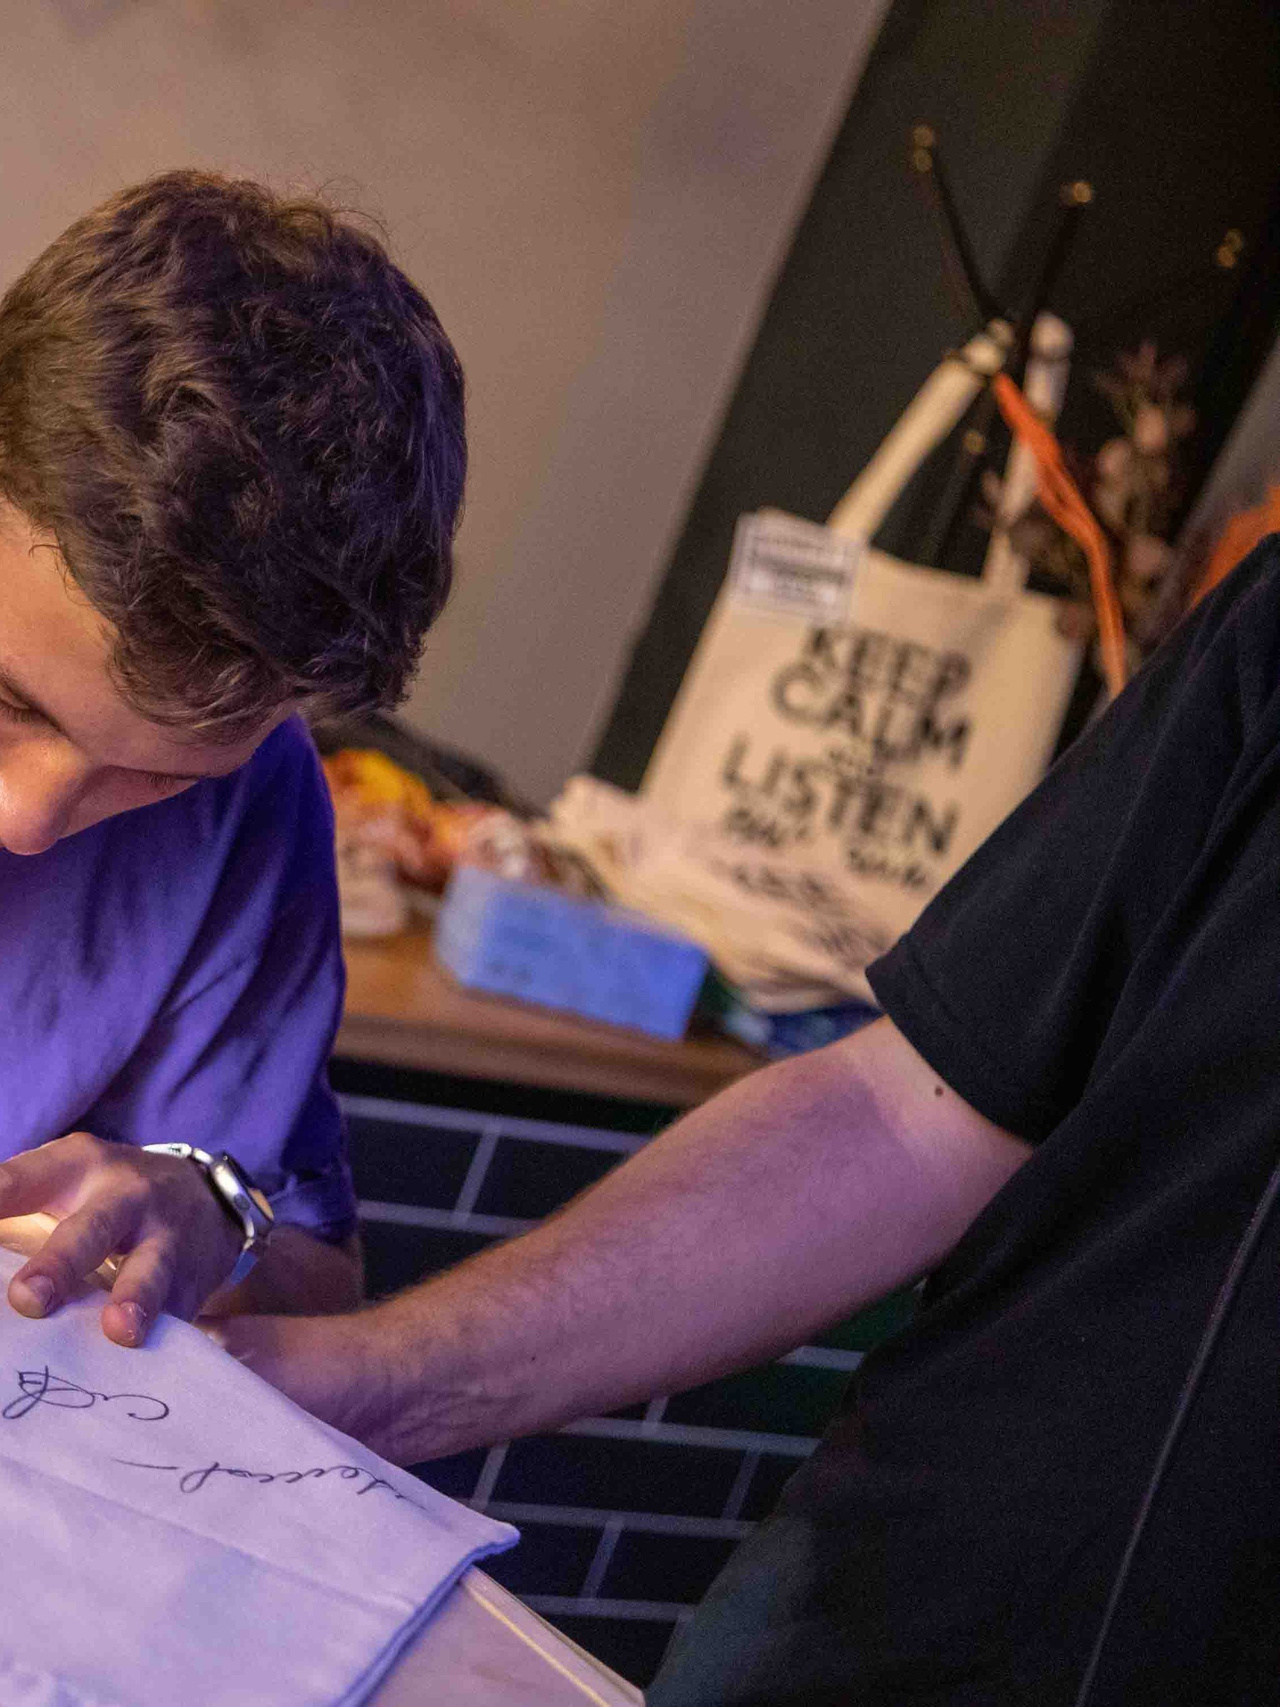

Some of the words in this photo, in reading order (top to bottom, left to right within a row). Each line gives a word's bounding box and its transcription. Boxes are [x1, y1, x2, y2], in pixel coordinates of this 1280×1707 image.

[803, 622, 973, 698] KEEP
[769, 661, 972, 773] CALM
[722, 733, 960, 856] LISTEN
